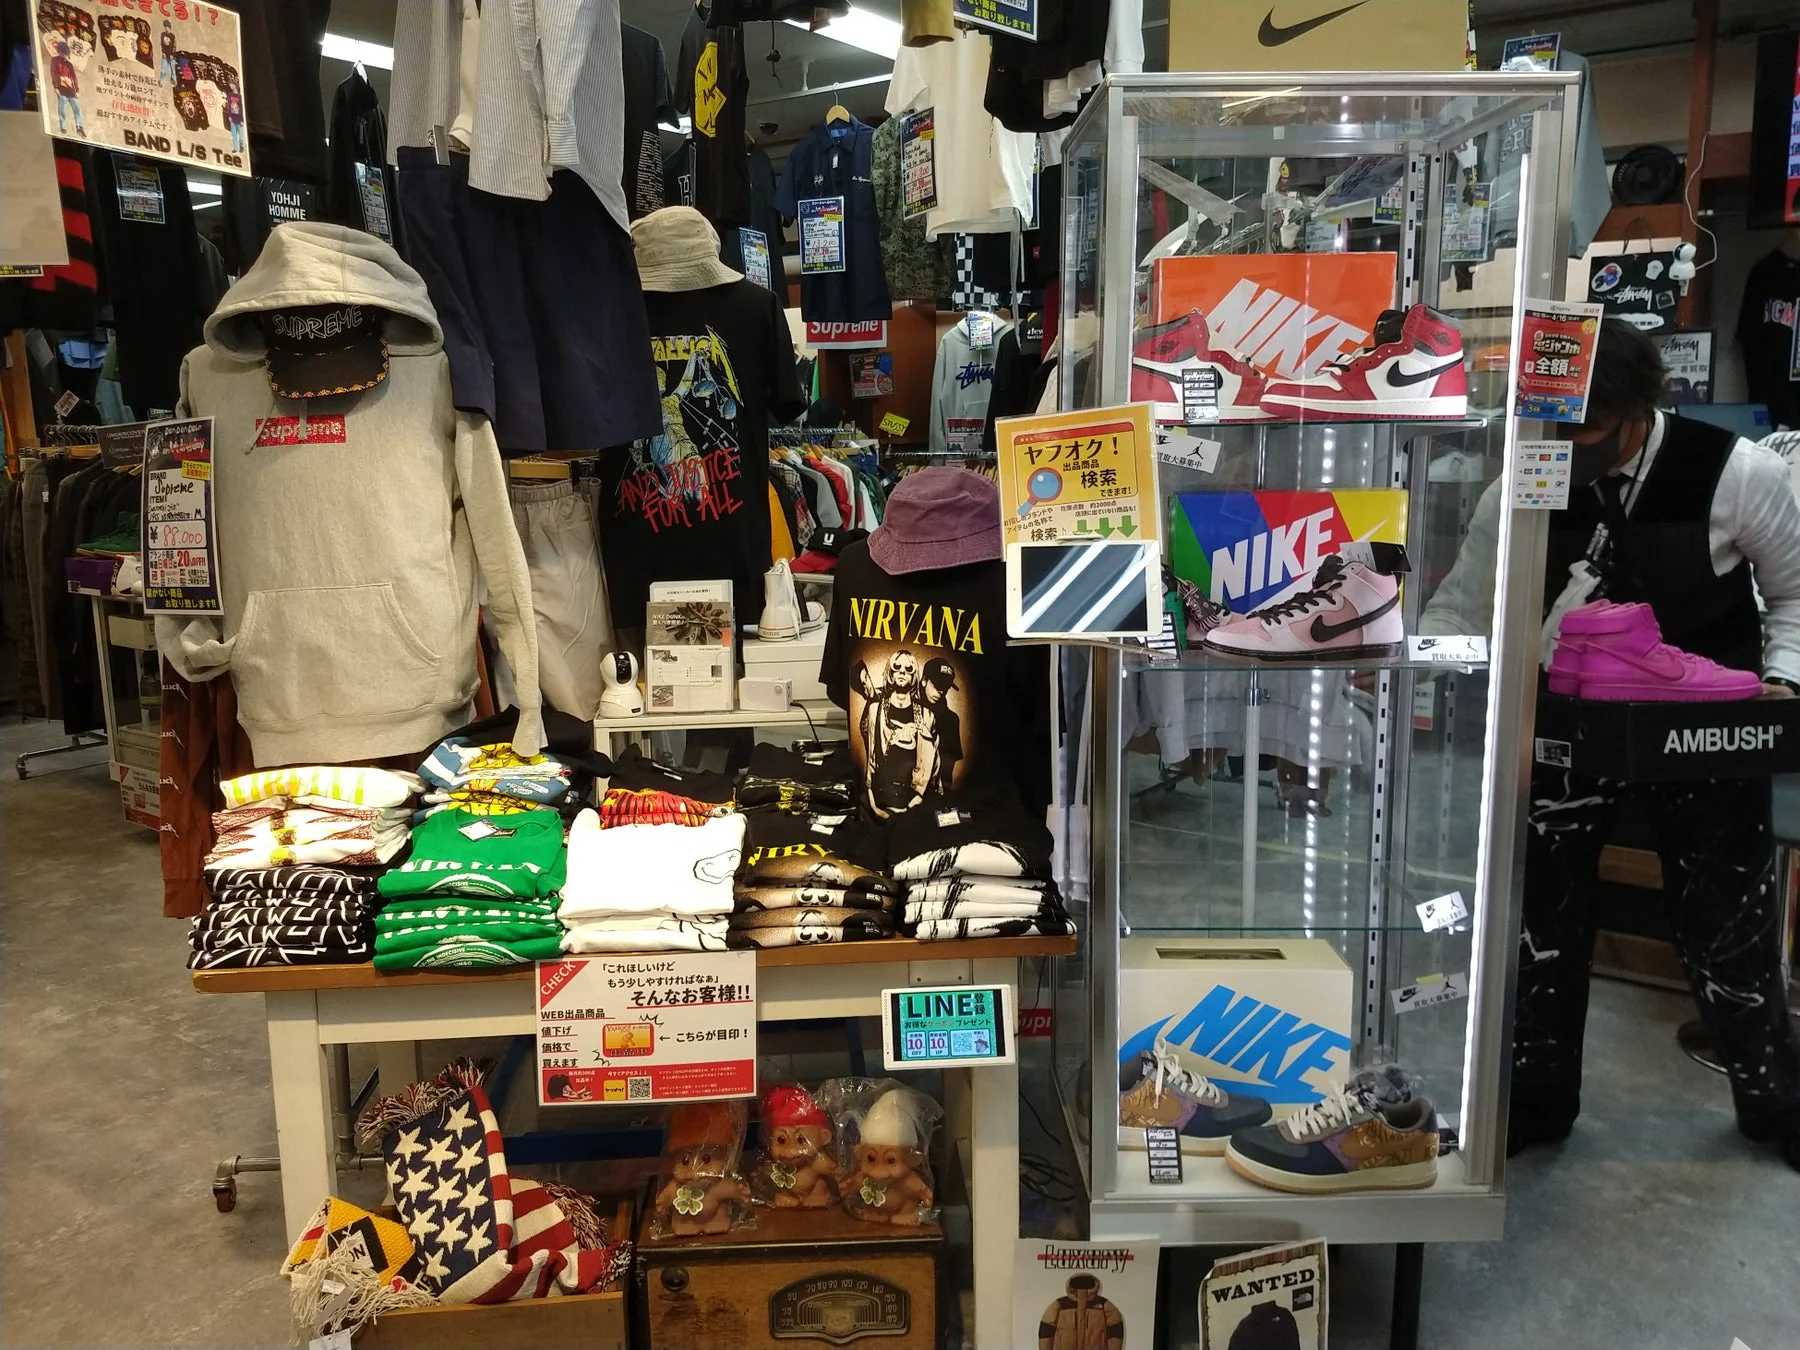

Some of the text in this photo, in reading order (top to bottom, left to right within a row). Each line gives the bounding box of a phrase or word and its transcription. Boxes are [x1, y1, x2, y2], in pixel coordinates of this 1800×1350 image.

[123, 128, 243, 168] BAND L/S Tee
[270, 190, 300, 207] YOHJI
[268, 204, 307, 221] HOMME
[272, 303, 363, 340] SUPREME
[811, 319, 880, 340] Supreme
[1205, 278, 1370, 381] NIKE
[1535, 356, 1569, 378] 全額
[1023, 436, 1119, 466] ヤフオク！
[1062, 459, 1100, 472] 出品商品
[620, 447, 741, 513] AND JUSTICE
[1080, 469, 1117, 489] 検索
[1099, 486, 1132, 498] できます!
[642, 483, 743, 534] FOR ALL
[1030, 527, 1058, 543] 検索
[1209, 507, 1335, 607] NIKE
[848, 597, 984, 655] NIRVANA
[540, 959, 577, 996] CHECK
[602, 961, 676, 974] 「これほしいけど
[630, 984, 751, 1007] そんなお客様!!
[907, 993, 987, 1019] LINE 登録
[541, 1008, 606, 1020] WEB出品商品
[541, 1026, 572, 1038] 値下げ
[675, 1028, 749, 1043] こちらが目印！
[1164, 984, 1351, 1084] NIKE
[541, 1041, 572, 1054] 価格で
[908, 1038, 923, 1051] 10
[930, 1038, 946, 1050] 10
[542, 1057, 579, 1068] 買えます
[1044, 1245, 1130, 1274] Luxury
[1211, 1268, 1316, 1304] WANTED
